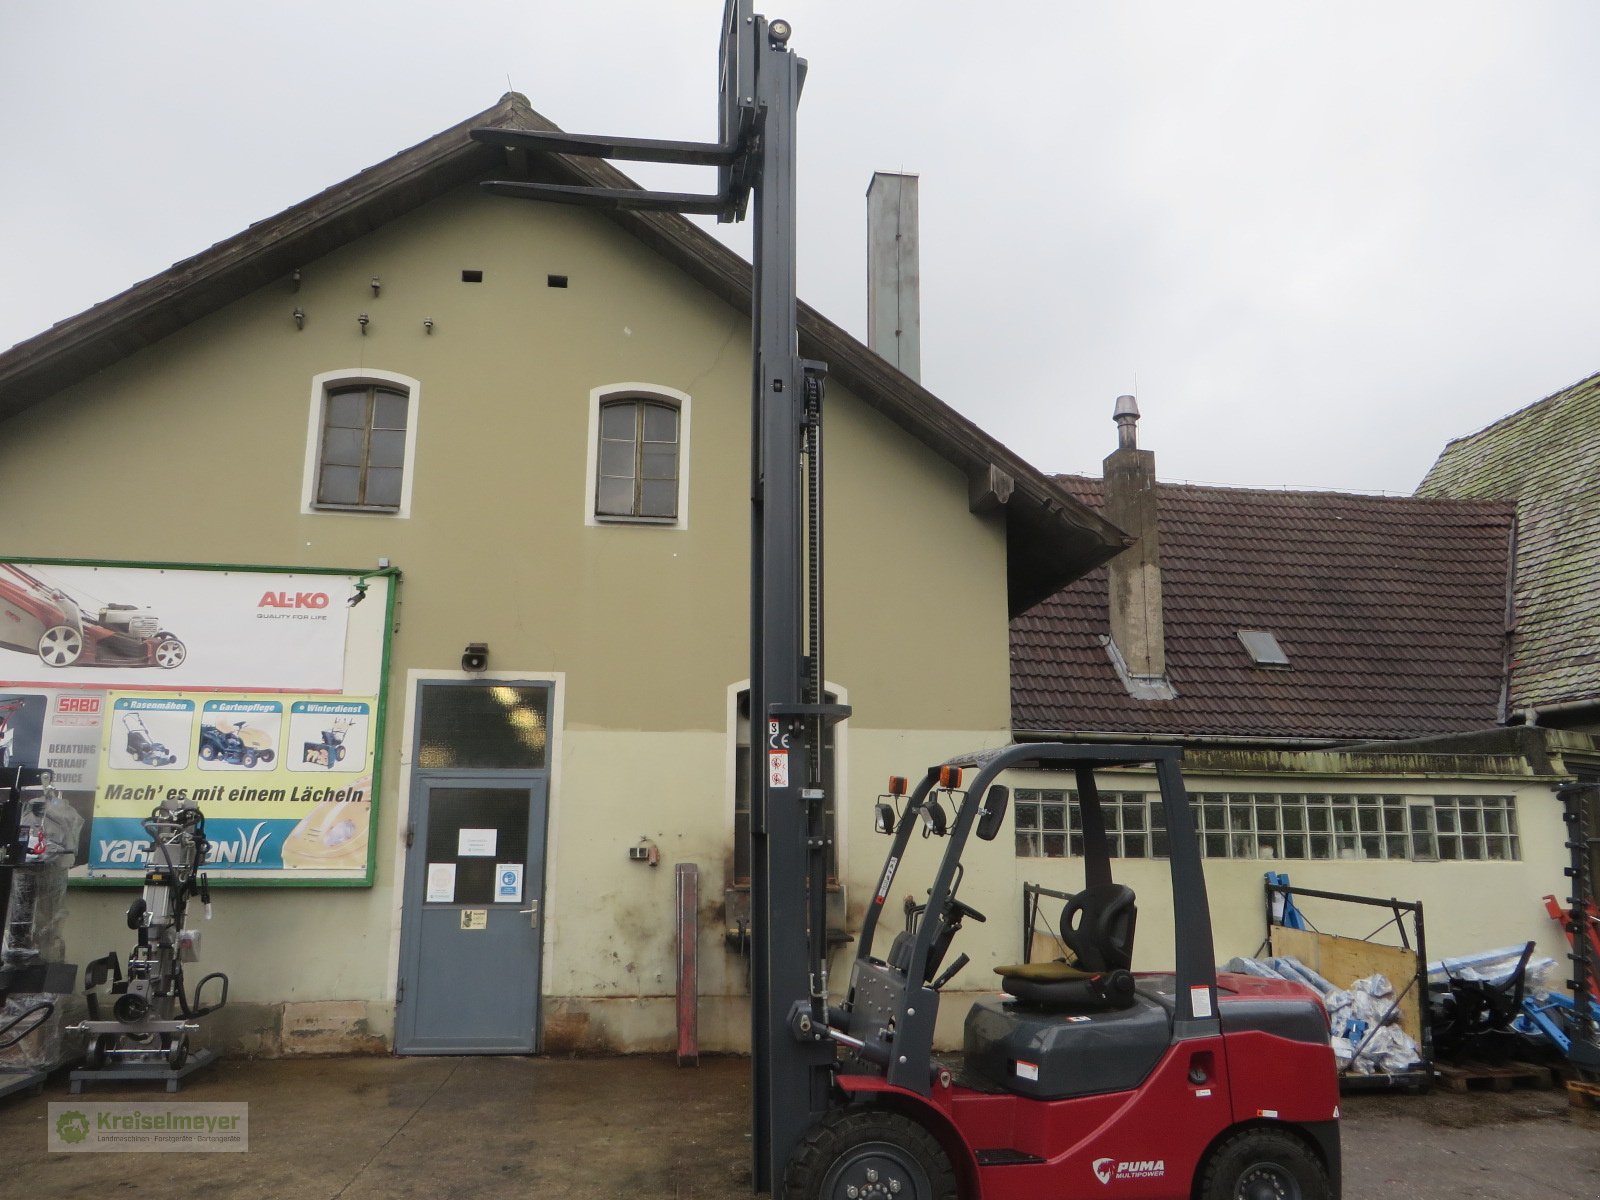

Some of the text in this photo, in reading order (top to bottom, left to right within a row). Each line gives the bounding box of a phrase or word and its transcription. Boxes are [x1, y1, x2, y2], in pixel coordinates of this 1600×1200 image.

[258, 591, 329, 609] AL-KO
[59, 698, 100, 712] SABO
[130, 700, 187, 711] Rasenmähen
[219, 702, 275, 713] Gartenpflege
[306, 704, 362, 714] Winterdienst
[48, 743, 97, 754] BERATUNG
[47, 758, 88, 769] VERKAUF
[52, 773, 83, 783] ERVICE
[166, 787, 188, 801] es
[192, 785, 225, 801] mit
[228, 785, 286, 802] einem
[290, 786, 364, 803] Lächeln
[1117, 1160, 1165, 1173] PUMA
[1115, 1170, 1165, 1179] MULTIPOWER
